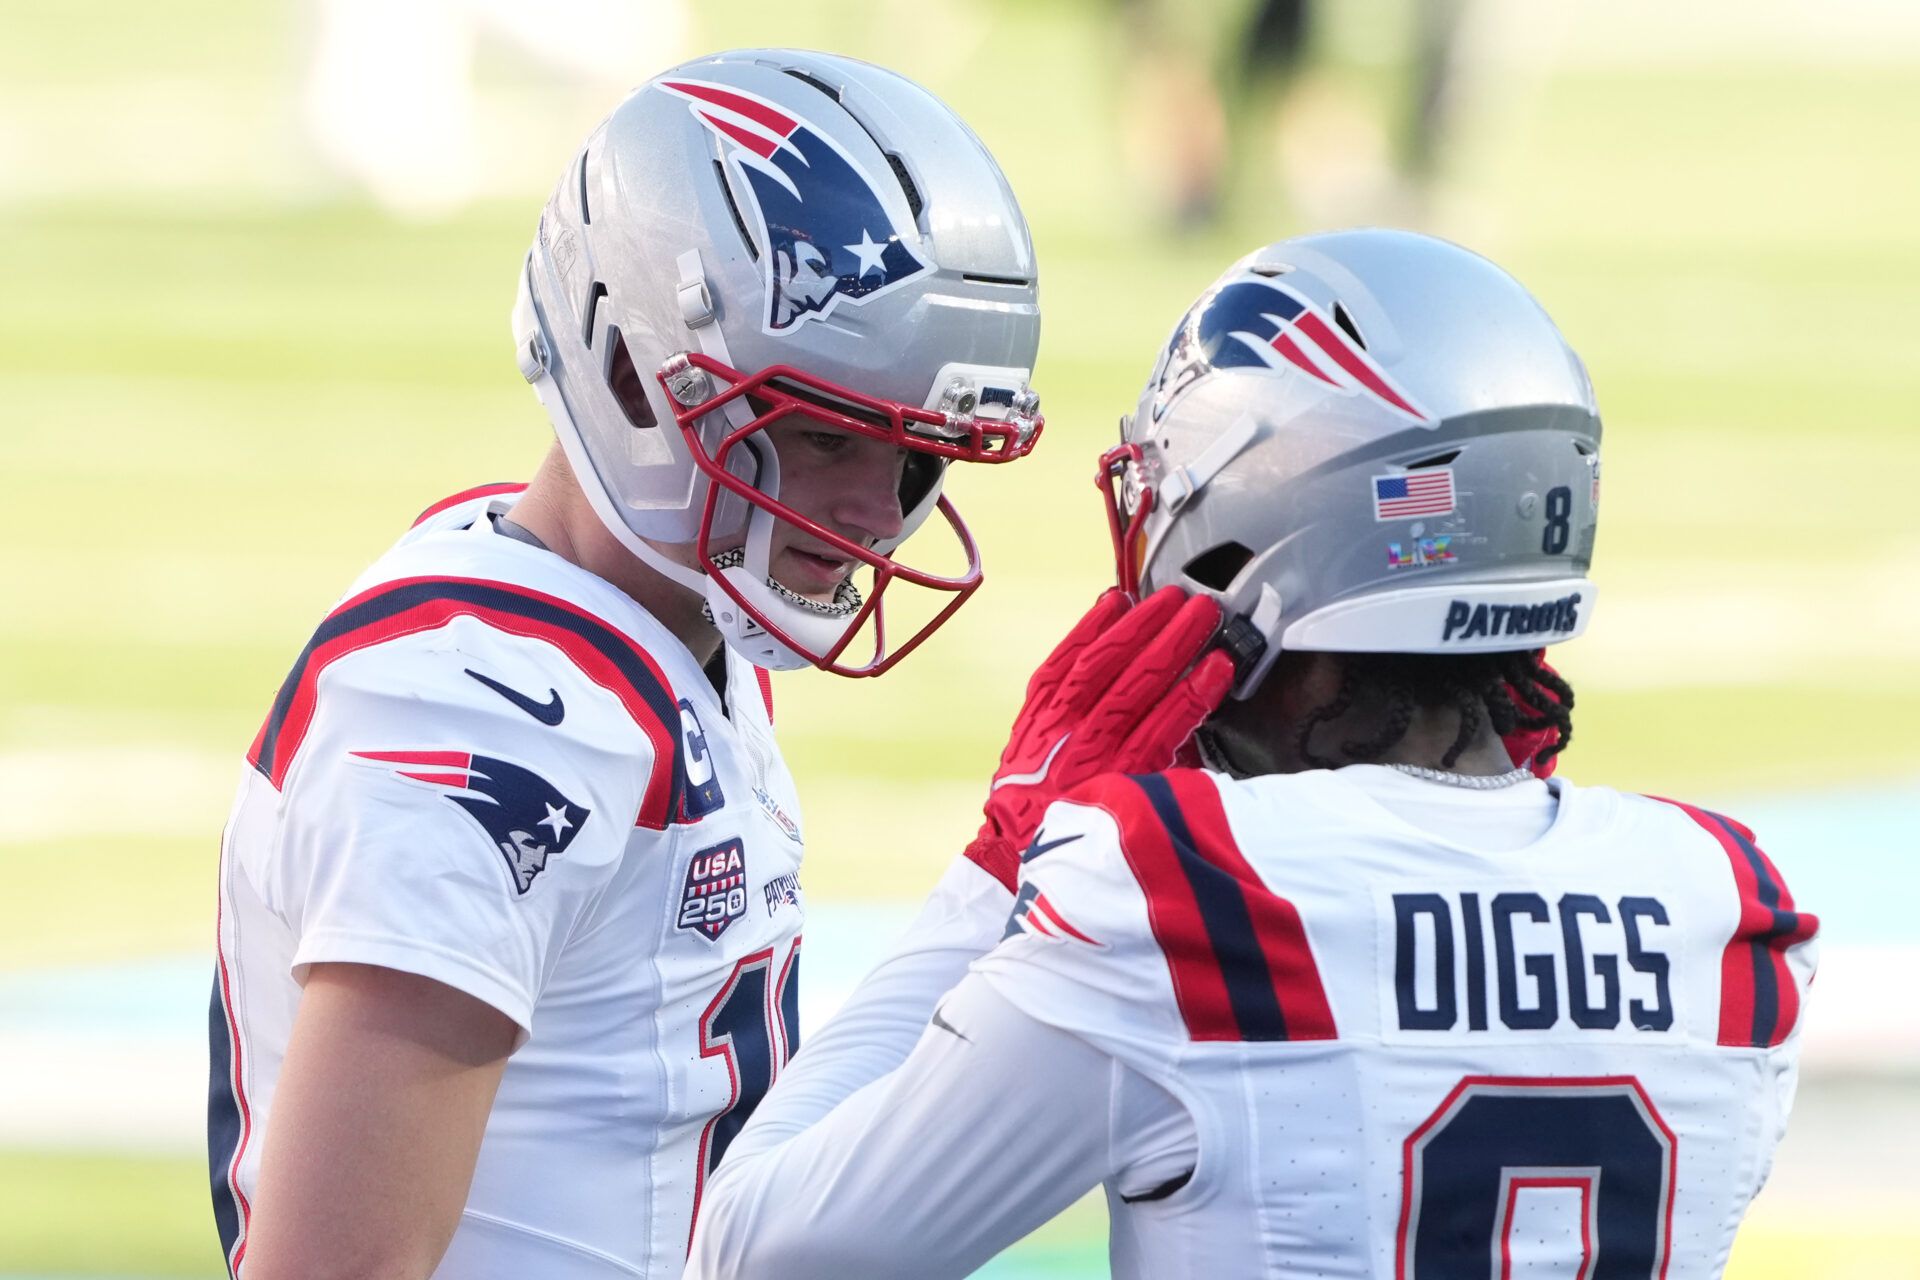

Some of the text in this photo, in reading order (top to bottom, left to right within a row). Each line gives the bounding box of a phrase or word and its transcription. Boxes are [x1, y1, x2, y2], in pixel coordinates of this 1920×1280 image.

[1541, 486, 1572, 556] 8
[1443, 592, 1582, 641] PATRIOTS
[680, 708, 713, 787] C
[692, 847, 742, 881] USA
[680, 887, 745, 926] 250
[1392, 892, 1674, 1033] DIGGS
[687, 934, 803, 1266] 1
